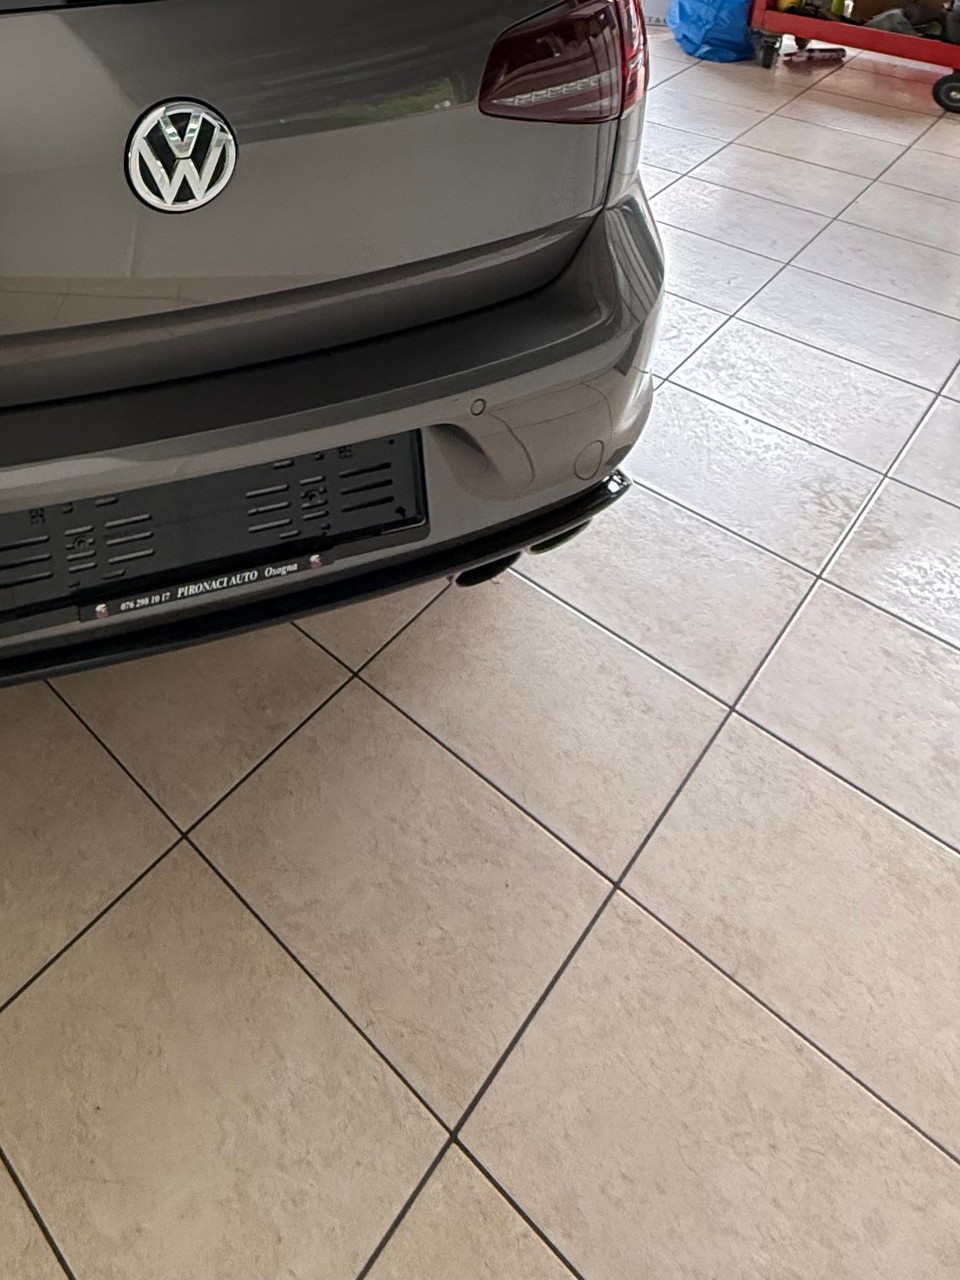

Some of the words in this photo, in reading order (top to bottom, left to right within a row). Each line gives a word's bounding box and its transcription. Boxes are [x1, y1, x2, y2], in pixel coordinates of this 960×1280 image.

[132, 101, 230, 208] VW
[120, 601, 135, 611] 076
[177, 577, 228, 598] PIRONACI
[229, 570, 258, 586] AUTO
[264, 563, 298, 577] Osogna
